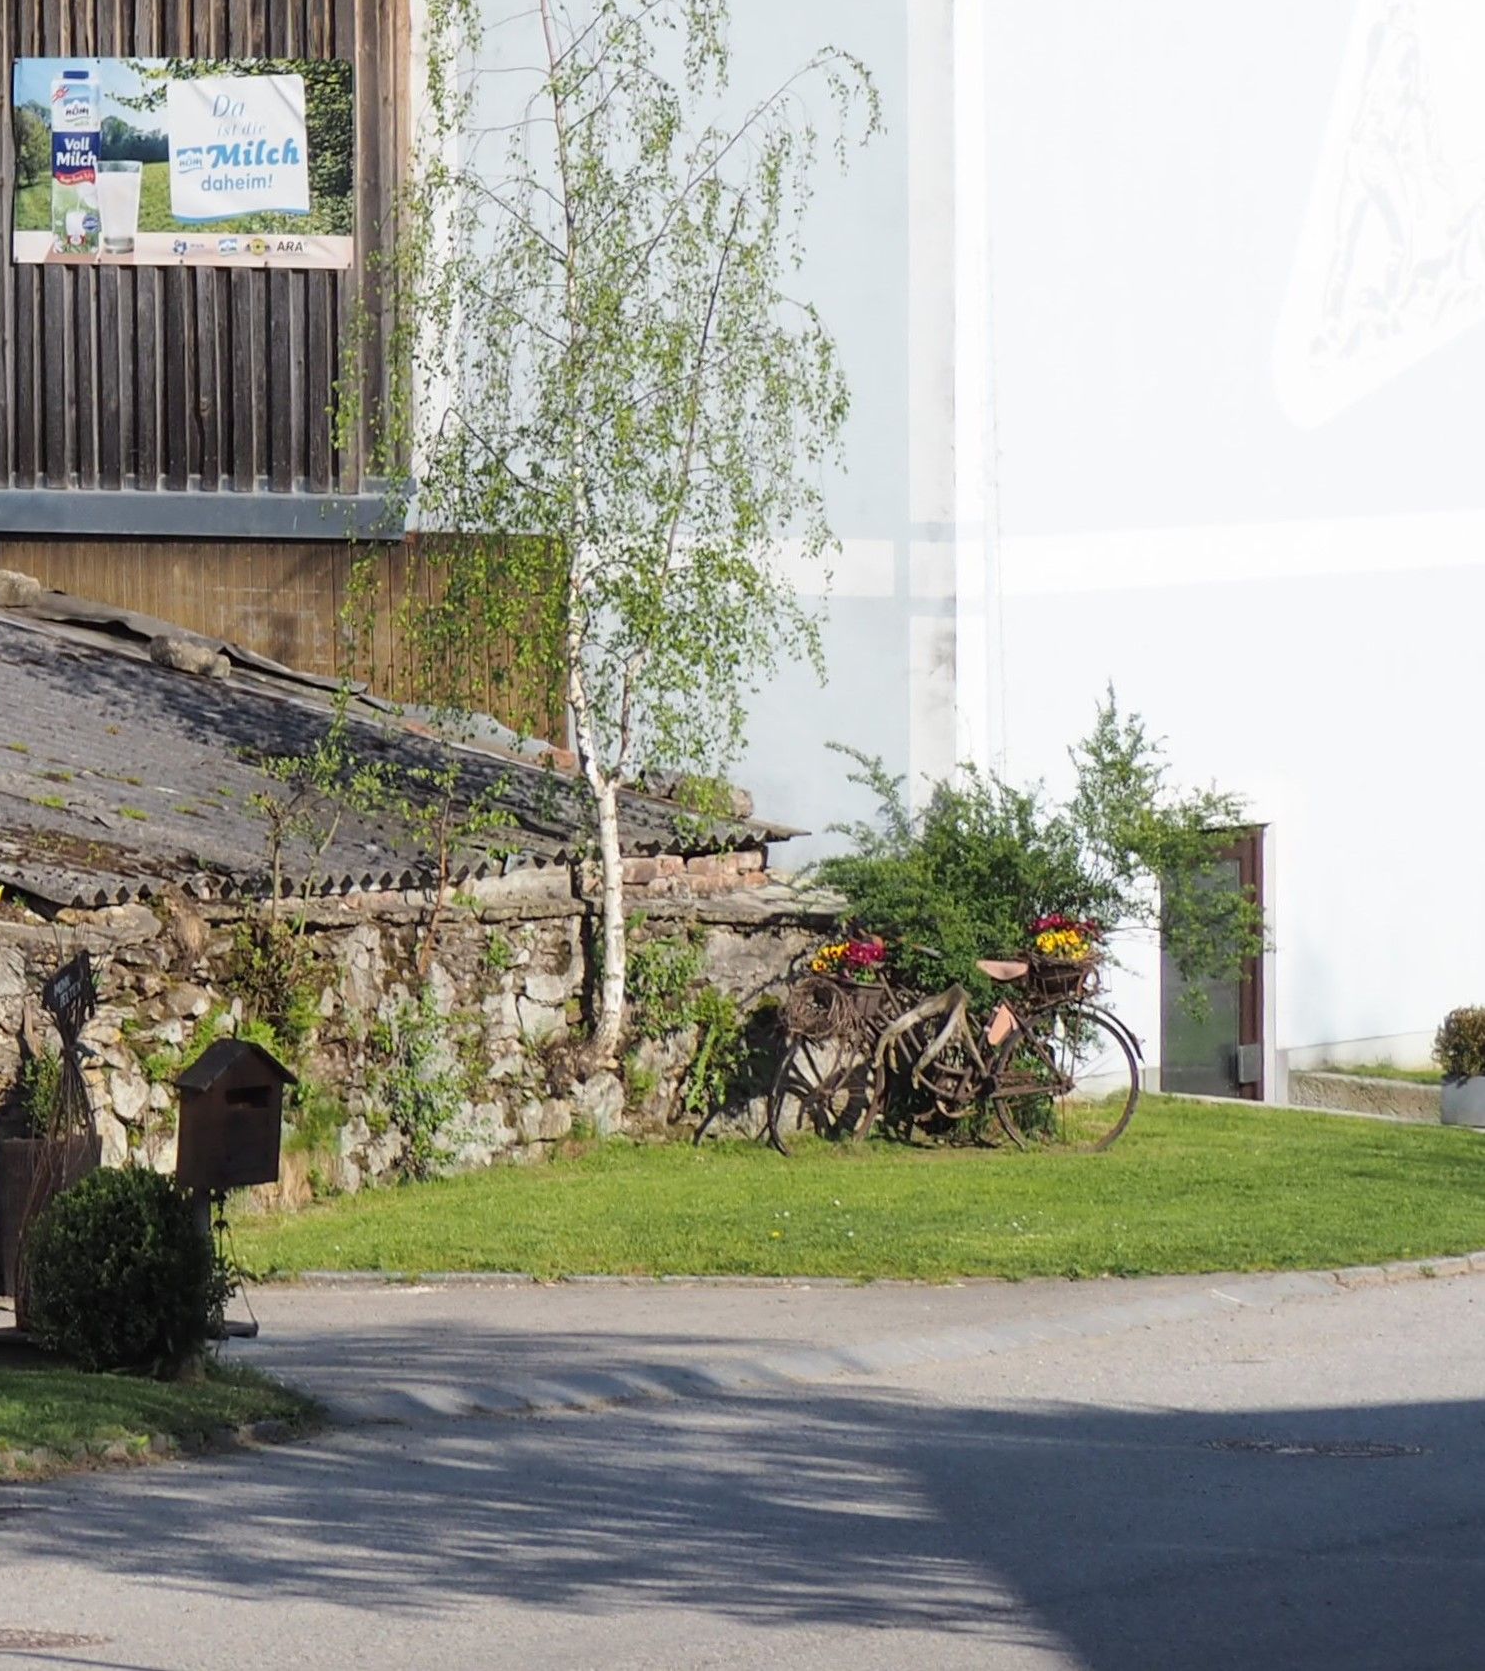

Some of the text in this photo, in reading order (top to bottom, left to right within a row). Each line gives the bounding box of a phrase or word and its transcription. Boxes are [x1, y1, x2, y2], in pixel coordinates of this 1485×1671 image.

[212, 94, 245, 117] Da
[64, 138, 90, 151] Voll
[206, 137, 300, 169] Milch
[56, 150, 97, 167] Milch
[201, 173, 273, 192] daheim!
[276, 241, 303, 252] ARA
